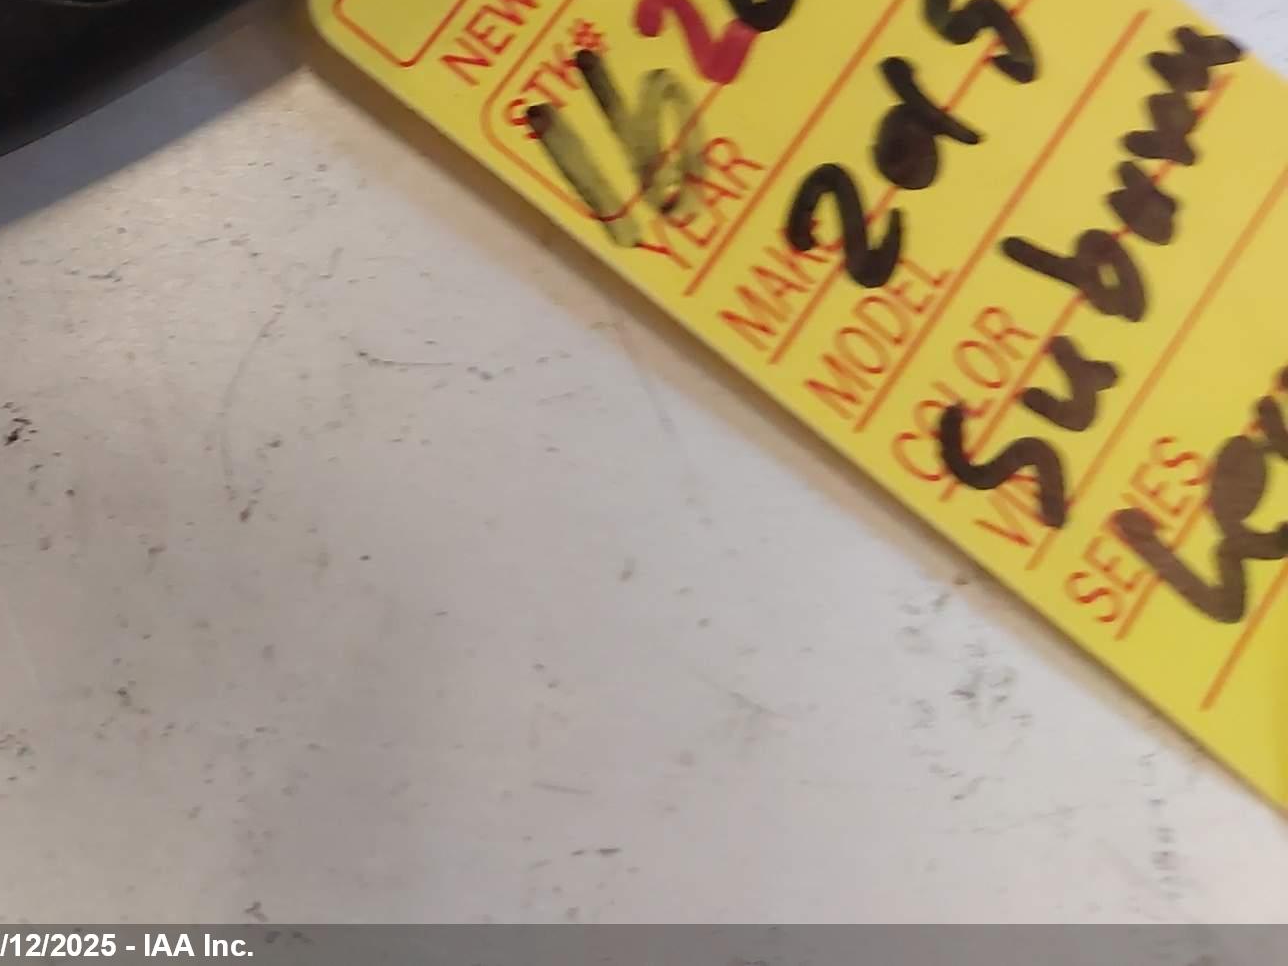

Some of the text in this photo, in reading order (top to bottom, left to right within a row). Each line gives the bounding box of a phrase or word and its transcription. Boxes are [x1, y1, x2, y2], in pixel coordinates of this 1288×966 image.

[507, 20, 609, 140] STK#
[634, 136, 767, 270] YEAR
[804, 257, 953, 420] MODEL
[891, 306, 1040, 483] COLOR
[1065, 436, 1208, 624] SEIES
